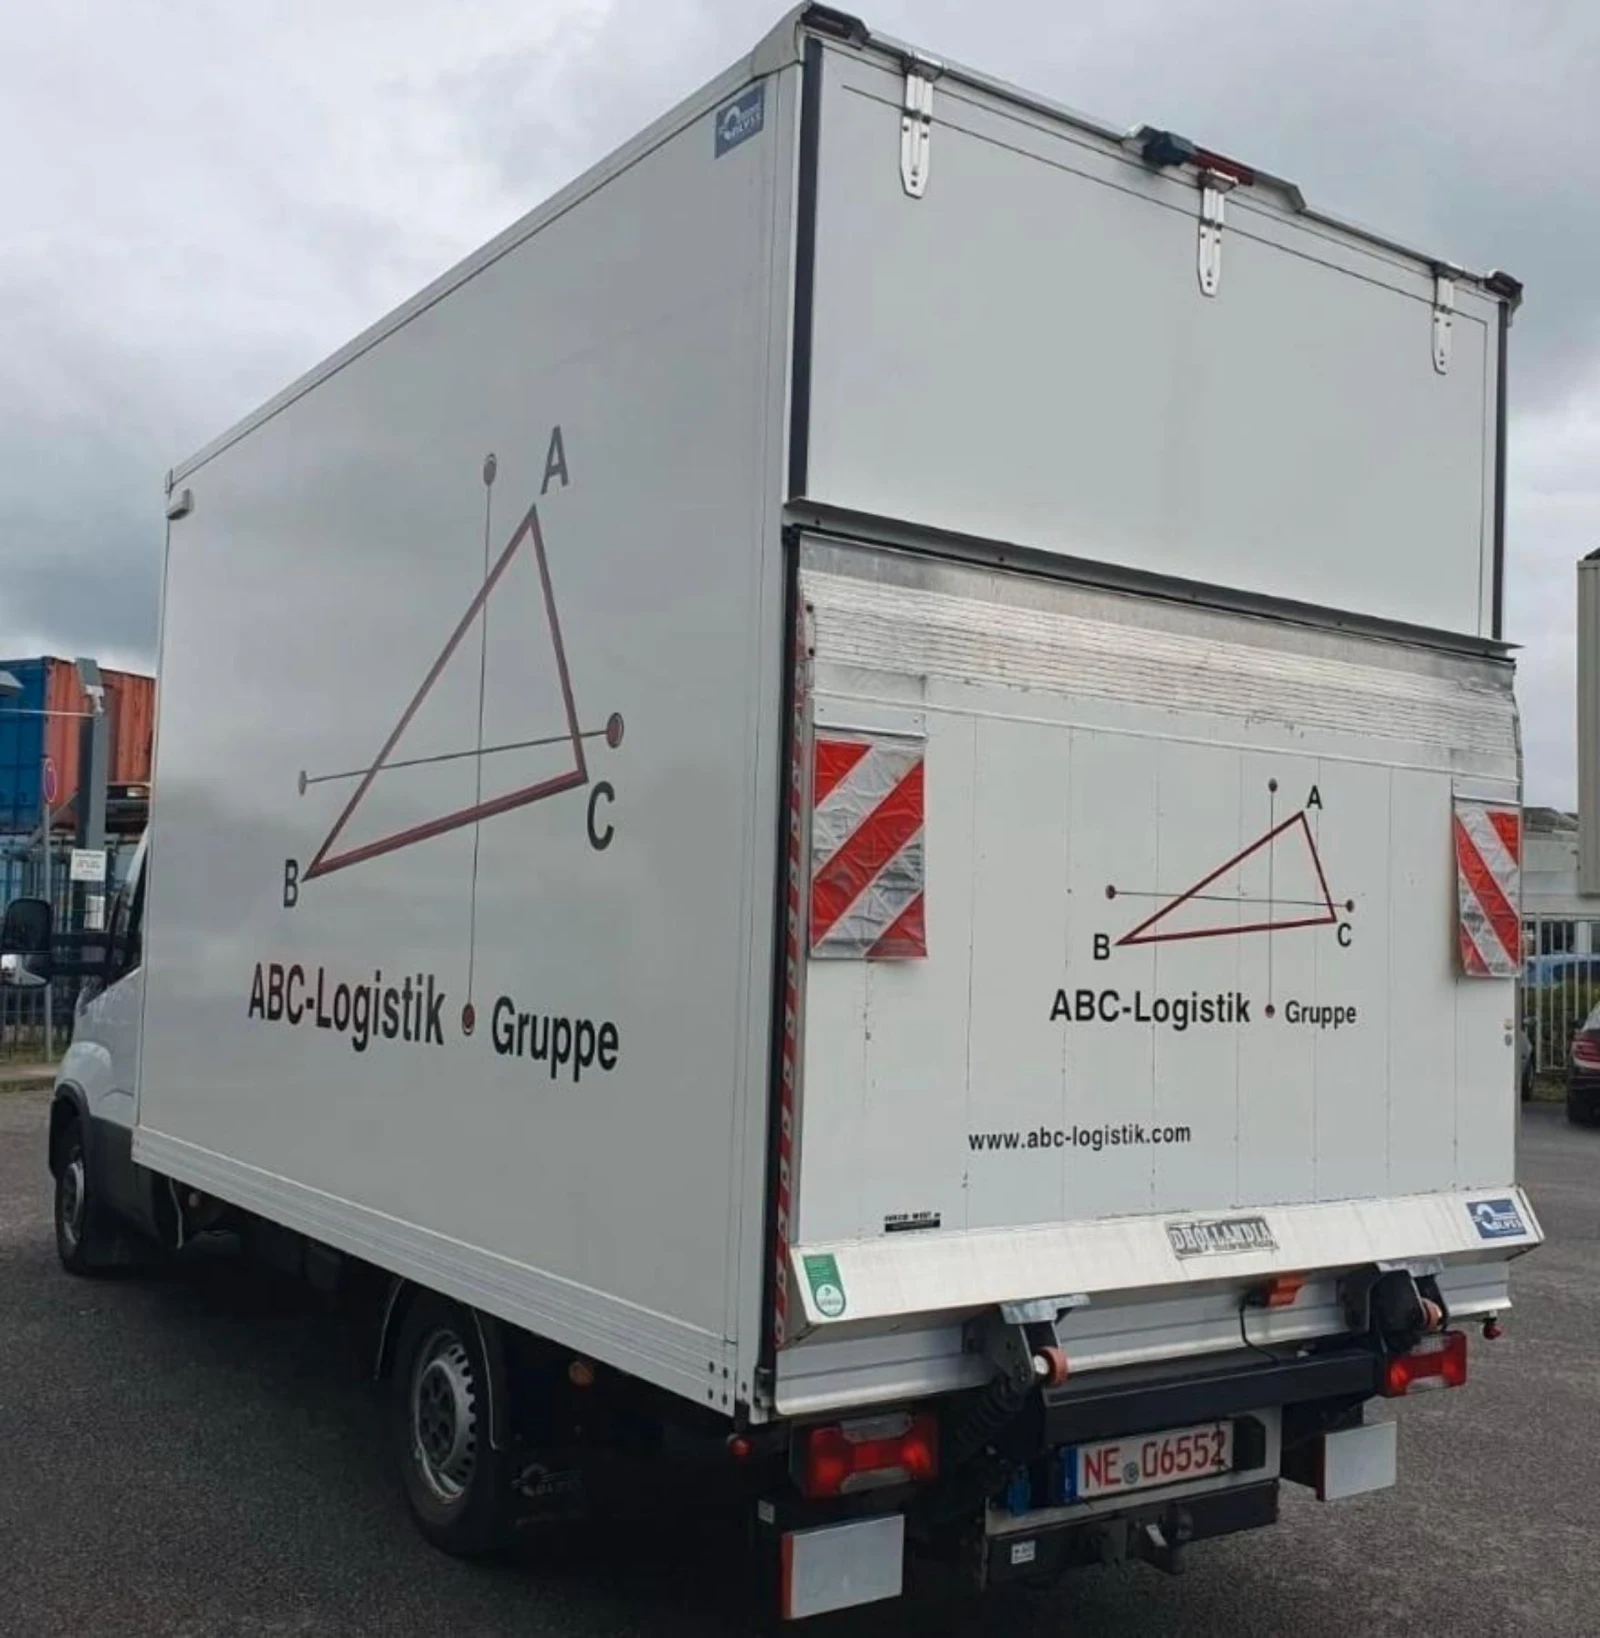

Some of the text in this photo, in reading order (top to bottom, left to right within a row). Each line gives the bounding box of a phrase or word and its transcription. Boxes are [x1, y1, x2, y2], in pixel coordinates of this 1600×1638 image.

[541, 425, 569, 495] A
[586, 781, 615, 851] C
[1307, 786, 1323, 810] A
[284, 859, 299, 908] B
[1093, 934, 1110, 961] B
[1337, 923, 1352, 948] C
[248, 962, 619, 1083] ABC-Logistik Gruppe
[1049, 988, 1357, 1032] ABC-Logistik Gruppe
[968, 1124, 1191, 1152] www.abc-logistik.com
[1084, 1430, 1227, 1489] NE 06552
